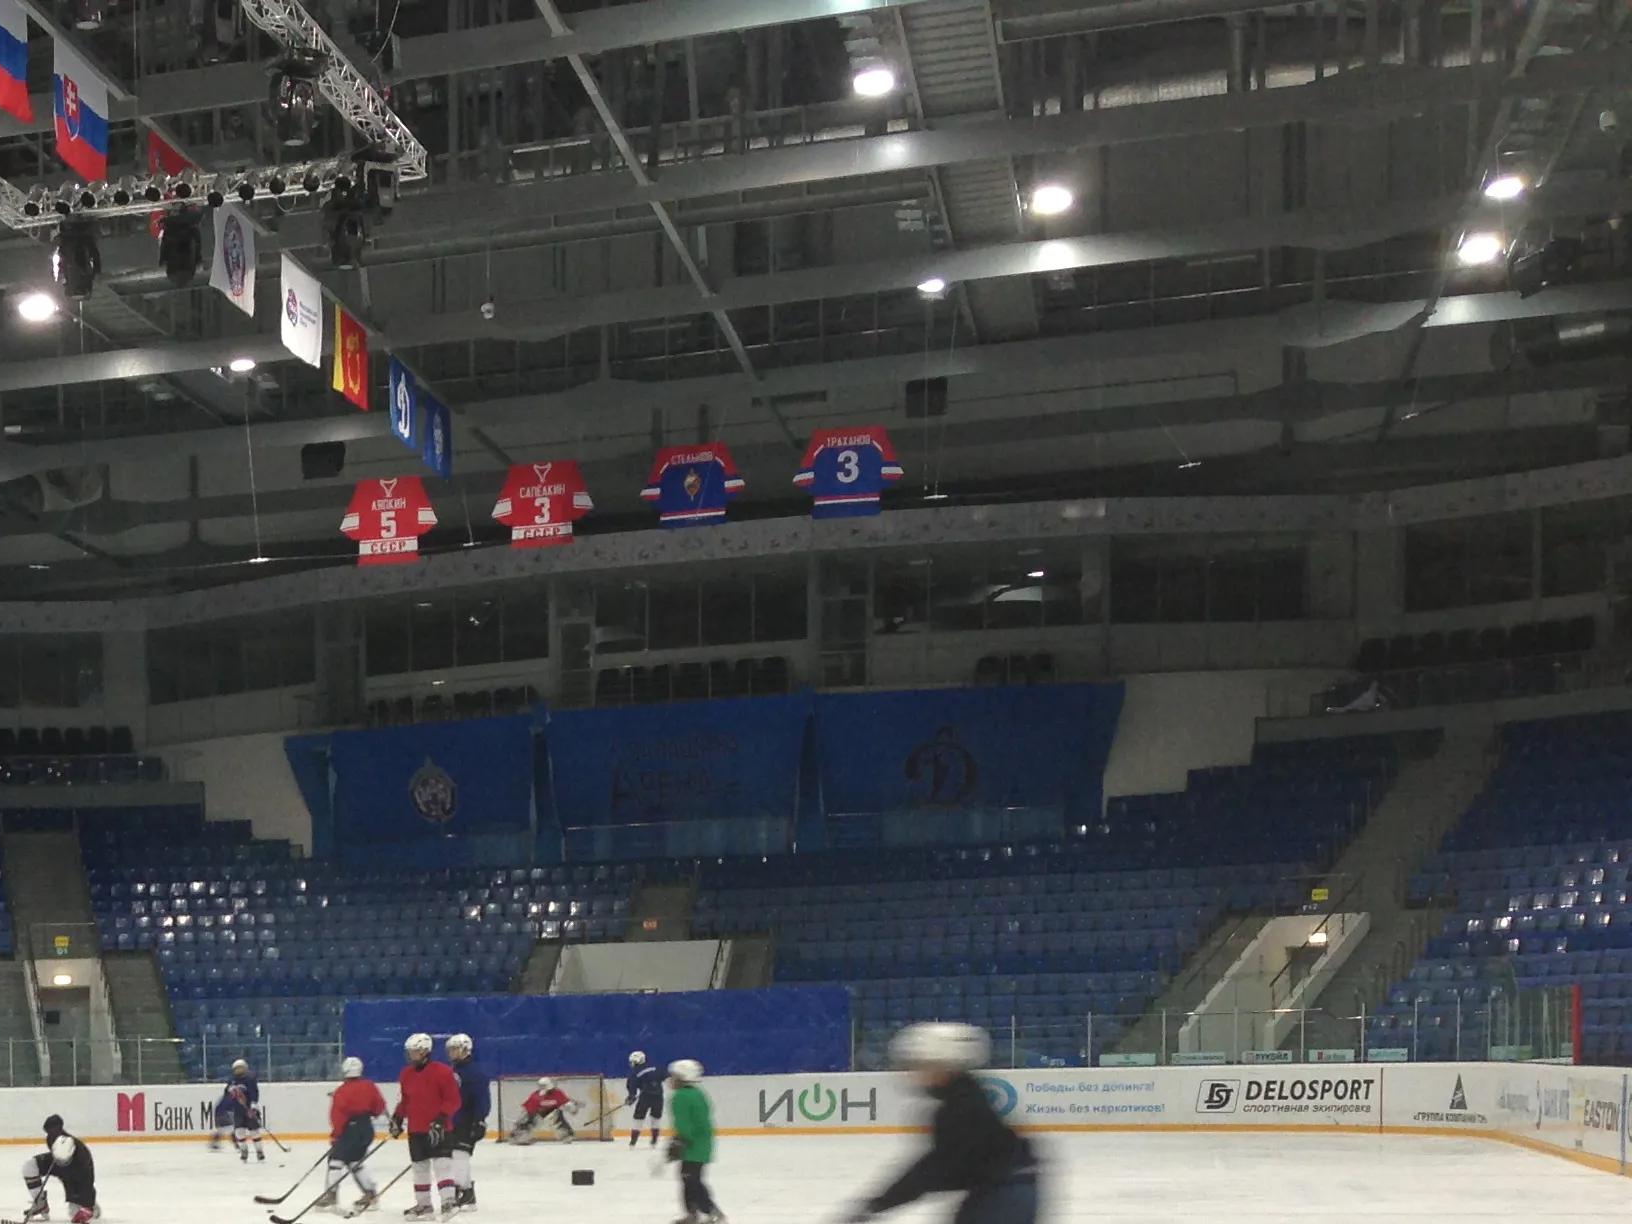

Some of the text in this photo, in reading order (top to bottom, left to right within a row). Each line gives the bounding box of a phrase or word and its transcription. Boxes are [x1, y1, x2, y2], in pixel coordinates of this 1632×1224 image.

[836, 450, 859, 484] 3
[534, 497, 550, 524] 3
[380, 511, 397, 538] 5
[371, 541, 406, 554] СССР
[1025, 1081, 1155, 1093] Победы без допинга!
[1245, 1079, 1375, 1101] DELOSPORT
[154, 1101, 194, 1131] Банк
[1025, 1103, 1165, 1115] Жизнь без наркотиков!
[1243, 1104, 1309, 1113] спортивная
